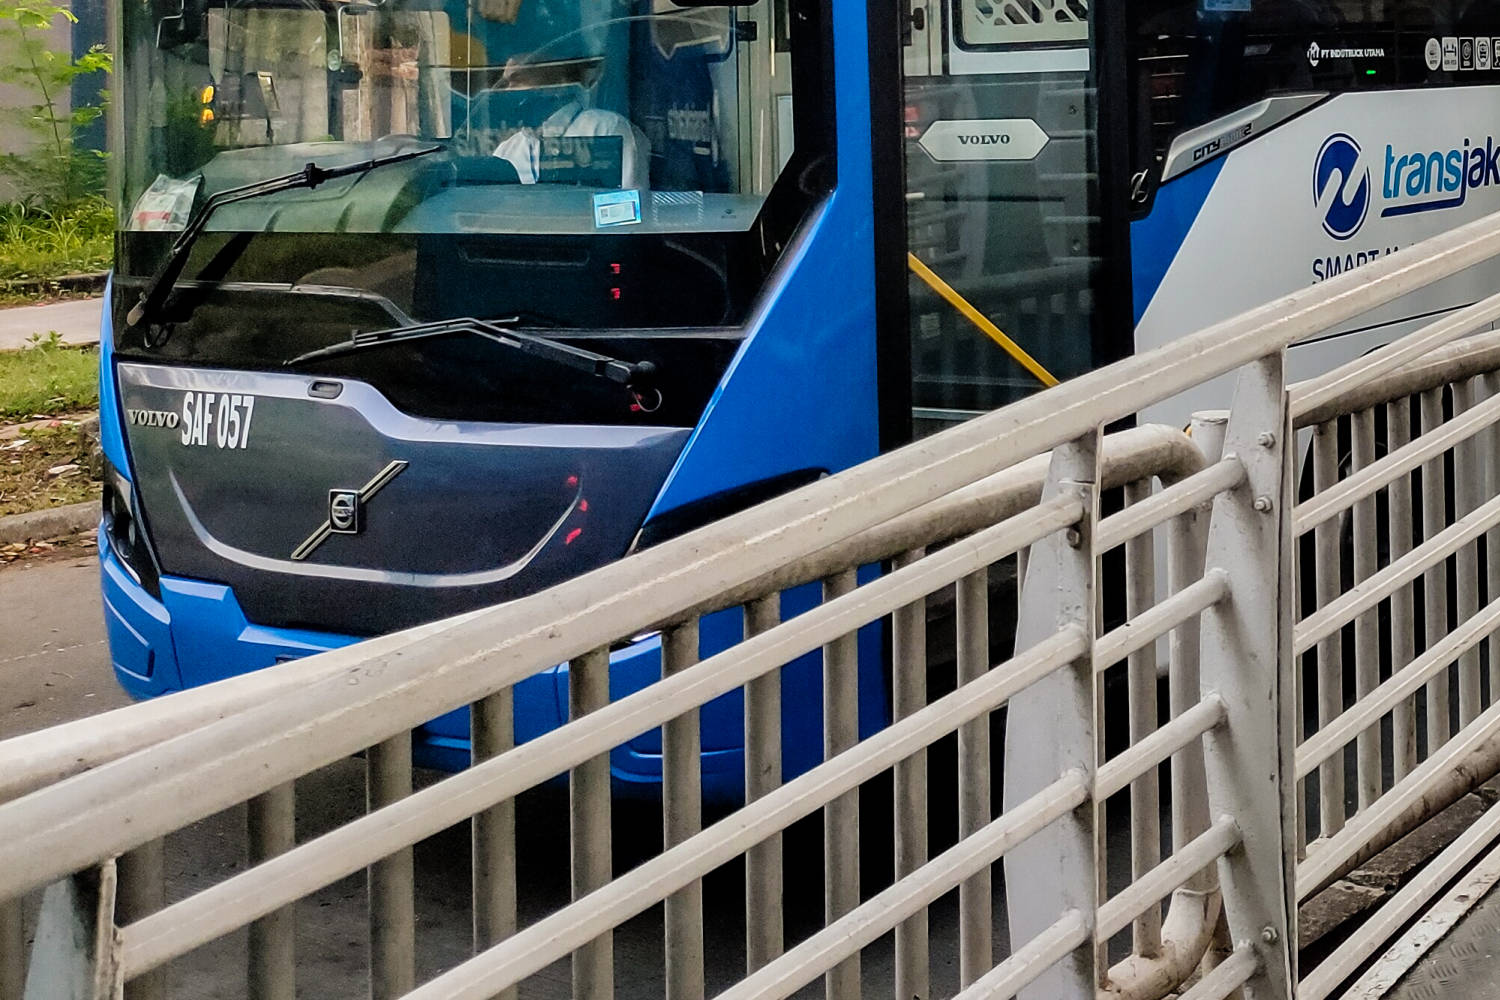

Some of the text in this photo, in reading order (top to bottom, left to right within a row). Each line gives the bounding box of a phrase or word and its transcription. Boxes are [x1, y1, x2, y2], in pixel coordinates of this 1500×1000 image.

[957, 134, 1011, 145] VOLVO
[127, 391, 255, 449] VOLVO SAF 057
